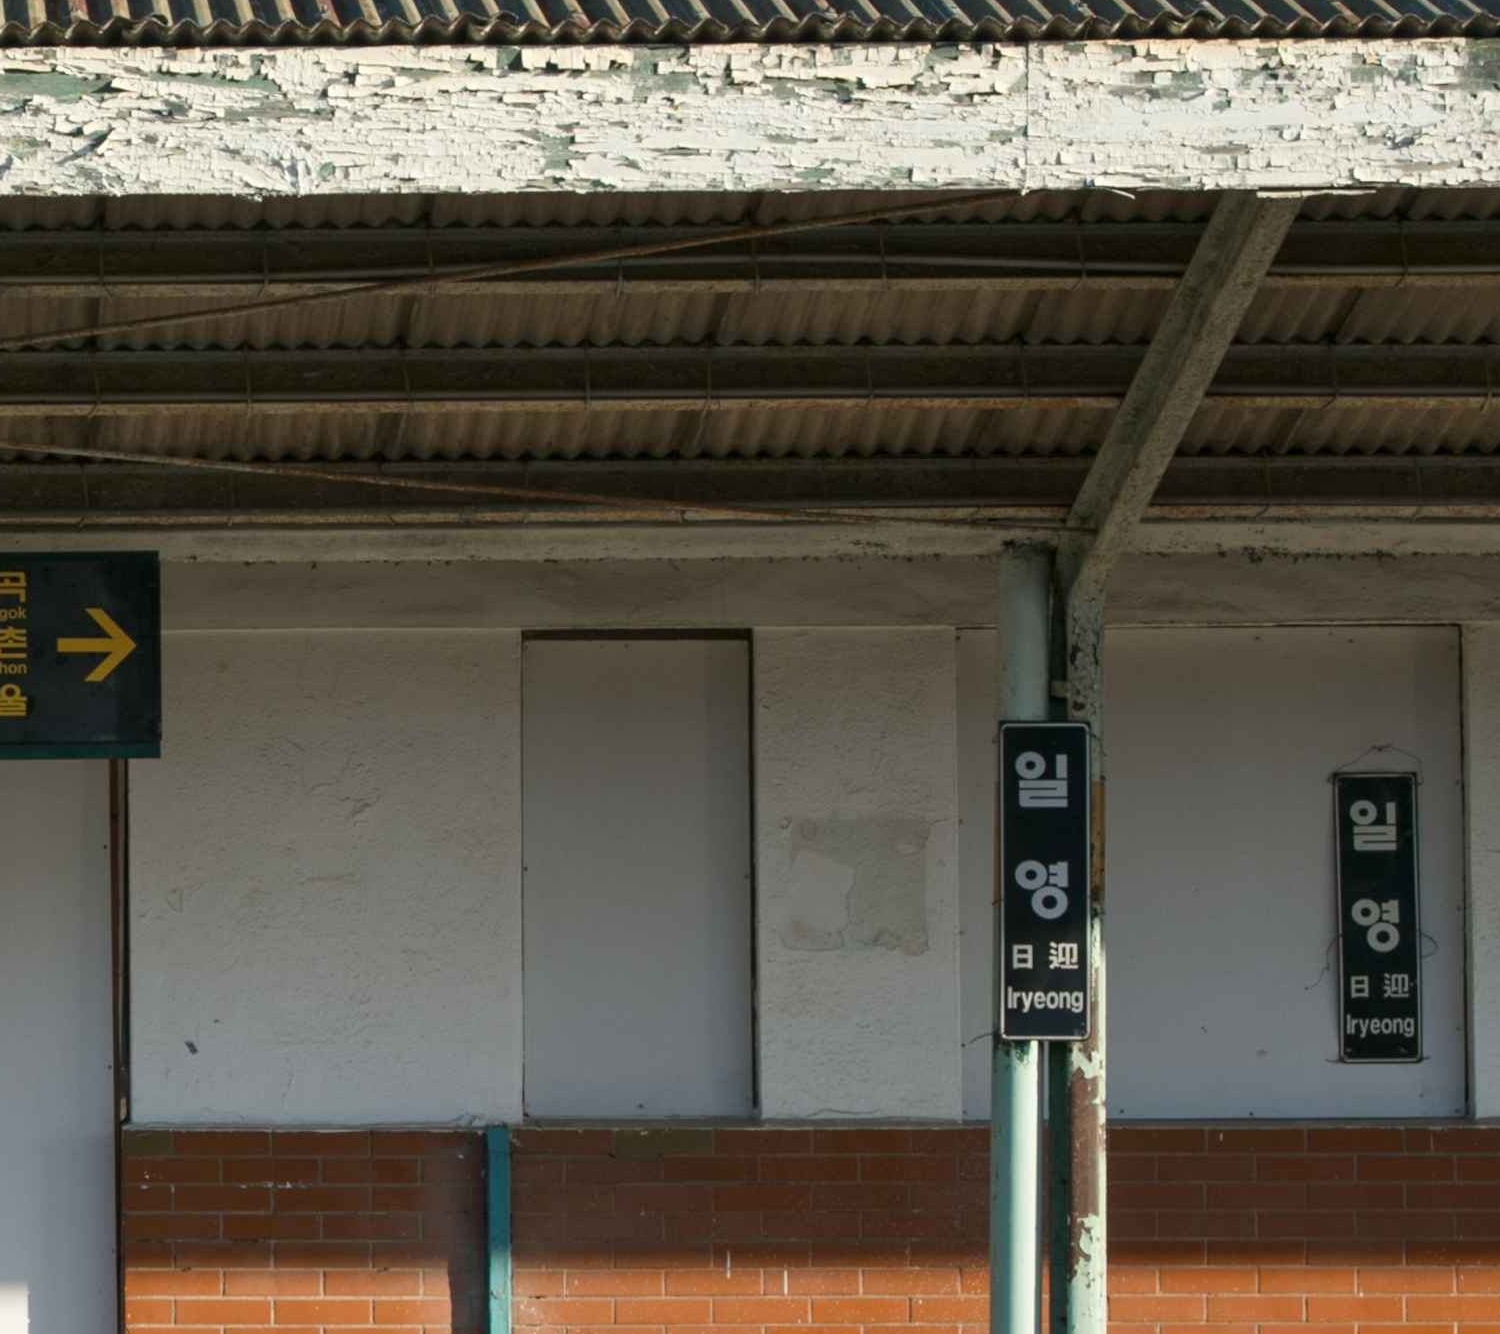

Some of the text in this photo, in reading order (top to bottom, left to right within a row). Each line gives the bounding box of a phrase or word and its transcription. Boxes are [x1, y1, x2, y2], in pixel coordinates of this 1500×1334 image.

[1014, 751, 1069, 920] 일영
[1349, 799, 1400, 953] 일영
[1007, 987, 1084, 1013] Iryeong
[1346, 1014, 1415, 1037] Iryeong
